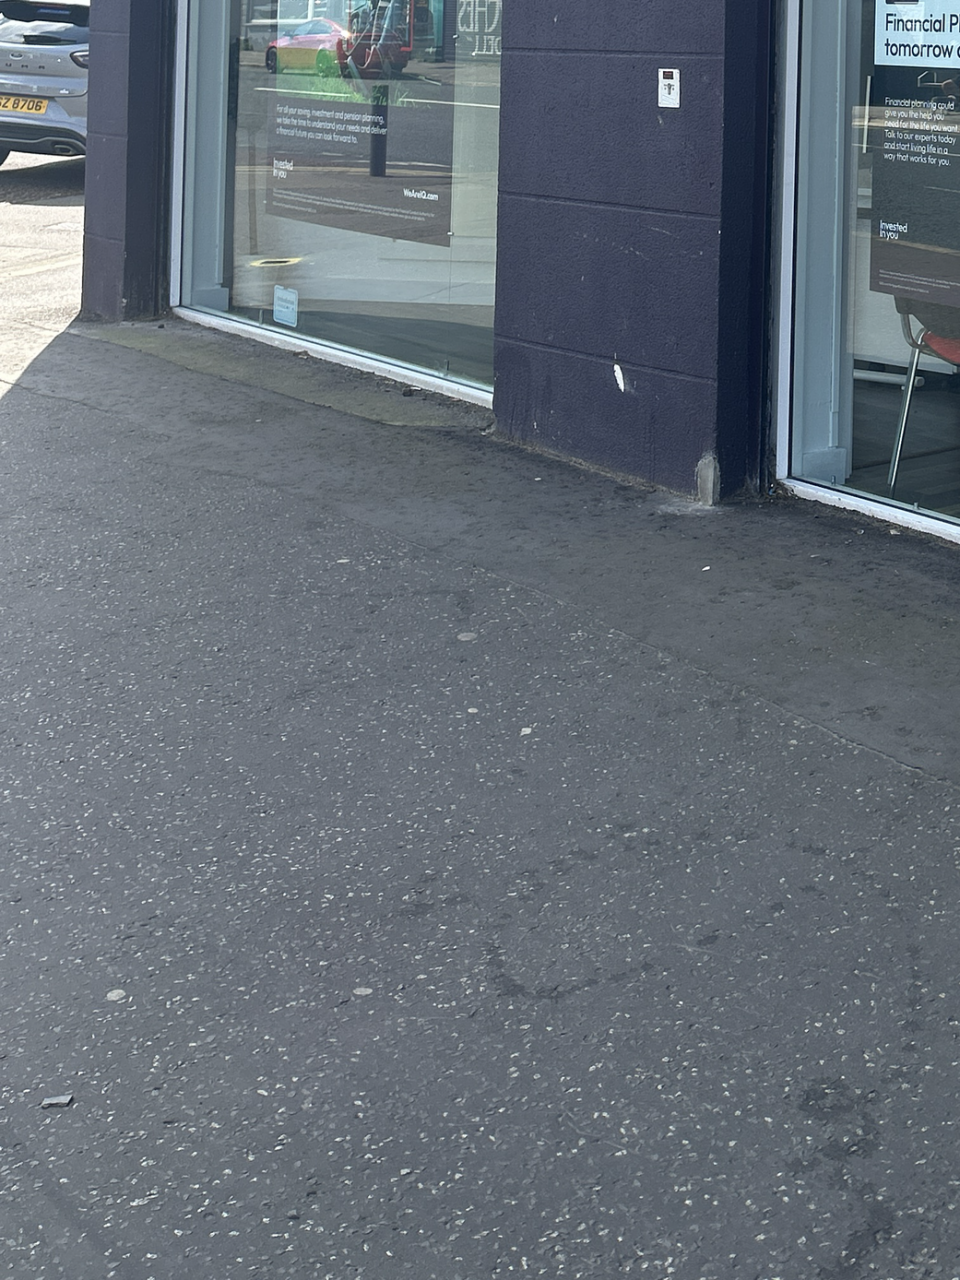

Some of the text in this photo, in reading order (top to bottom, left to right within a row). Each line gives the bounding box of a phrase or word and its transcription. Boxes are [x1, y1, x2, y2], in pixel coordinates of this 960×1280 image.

[885, 13, 946, 33] Financial
[885, 38, 953, 58] tomorrow
[12, 98, 43, 111] 8706
[884, 96, 955, 111] Financial planning could
[884, 109, 945, 121] give you the help you
[884, 120, 960, 133] need for the life you want.
[884, 130, 896, 138] Talk
[897, 131, 903, 139] to
[914, 133, 937, 143] experts
[938, 134, 957, 146] today
[883, 141, 896, 150] and
[896, 142, 910, 151] start
[911, 142, 926, 154] living
[926, 144, 937, 154] life
[937, 146, 943, 154] in
[273, 157, 294, 171] Invested
[883, 152, 952, 167] way that works for you.
[403, 187, 439, 201] WeAreIQ.com
[879, 219, 908, 233] Invested
[886, 231, 899, 241] you
